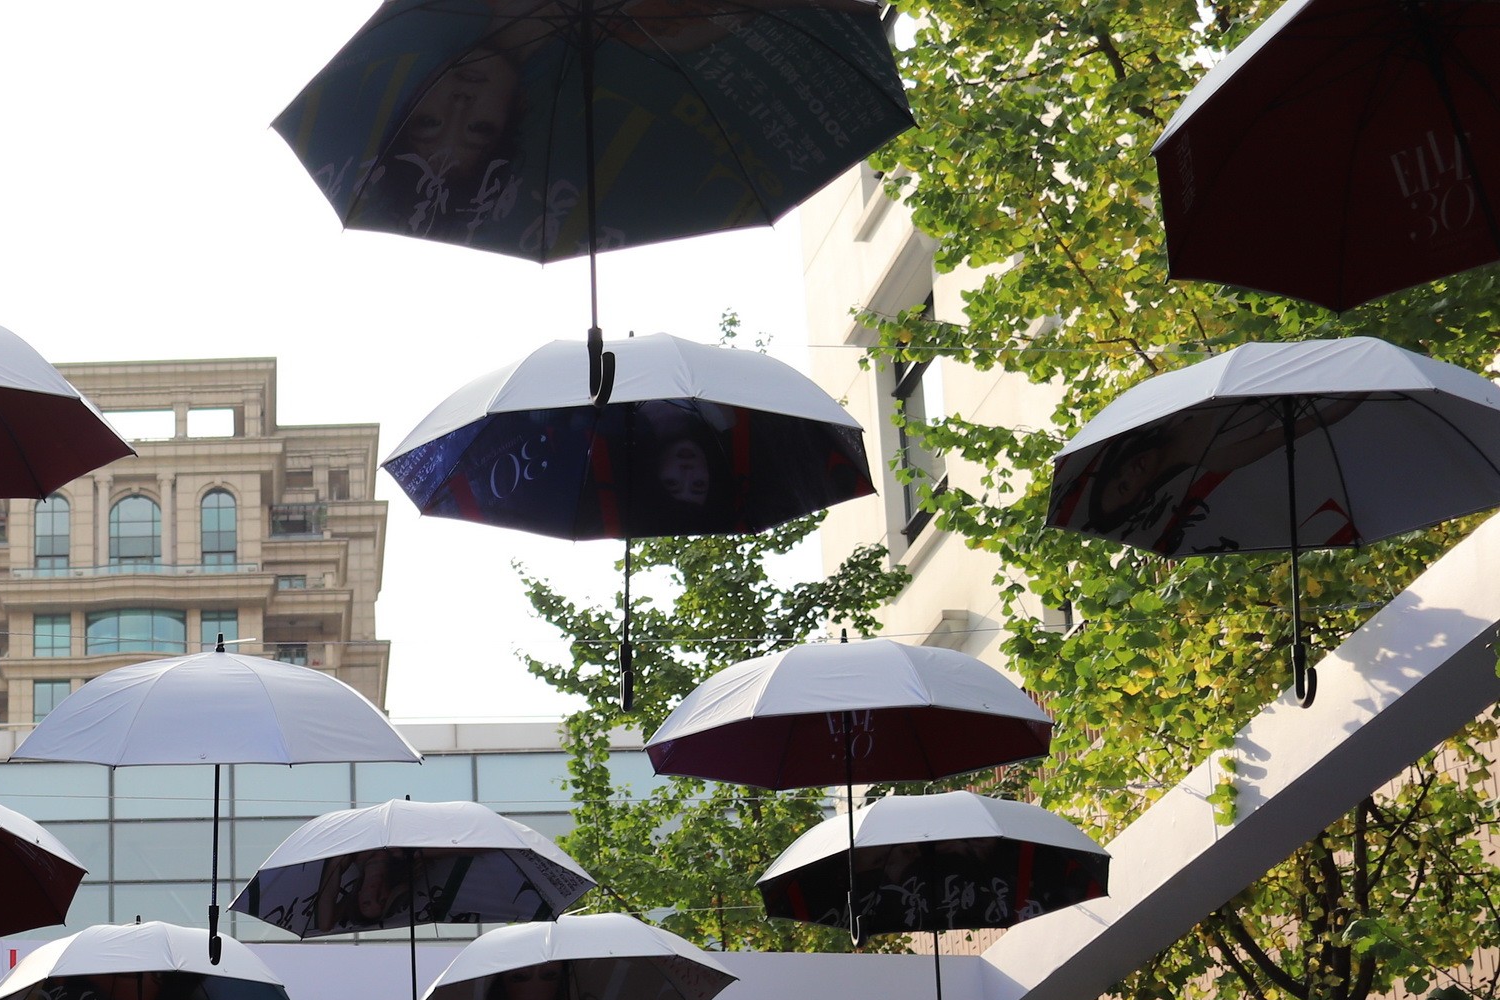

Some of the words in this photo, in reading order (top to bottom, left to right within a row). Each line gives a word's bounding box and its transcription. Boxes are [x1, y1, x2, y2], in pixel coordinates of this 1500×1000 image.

[1389, 130, 1476, 198] ELLE
[1408, 182, 1476, 242] 30
[489, 434, 548, 500] 30
